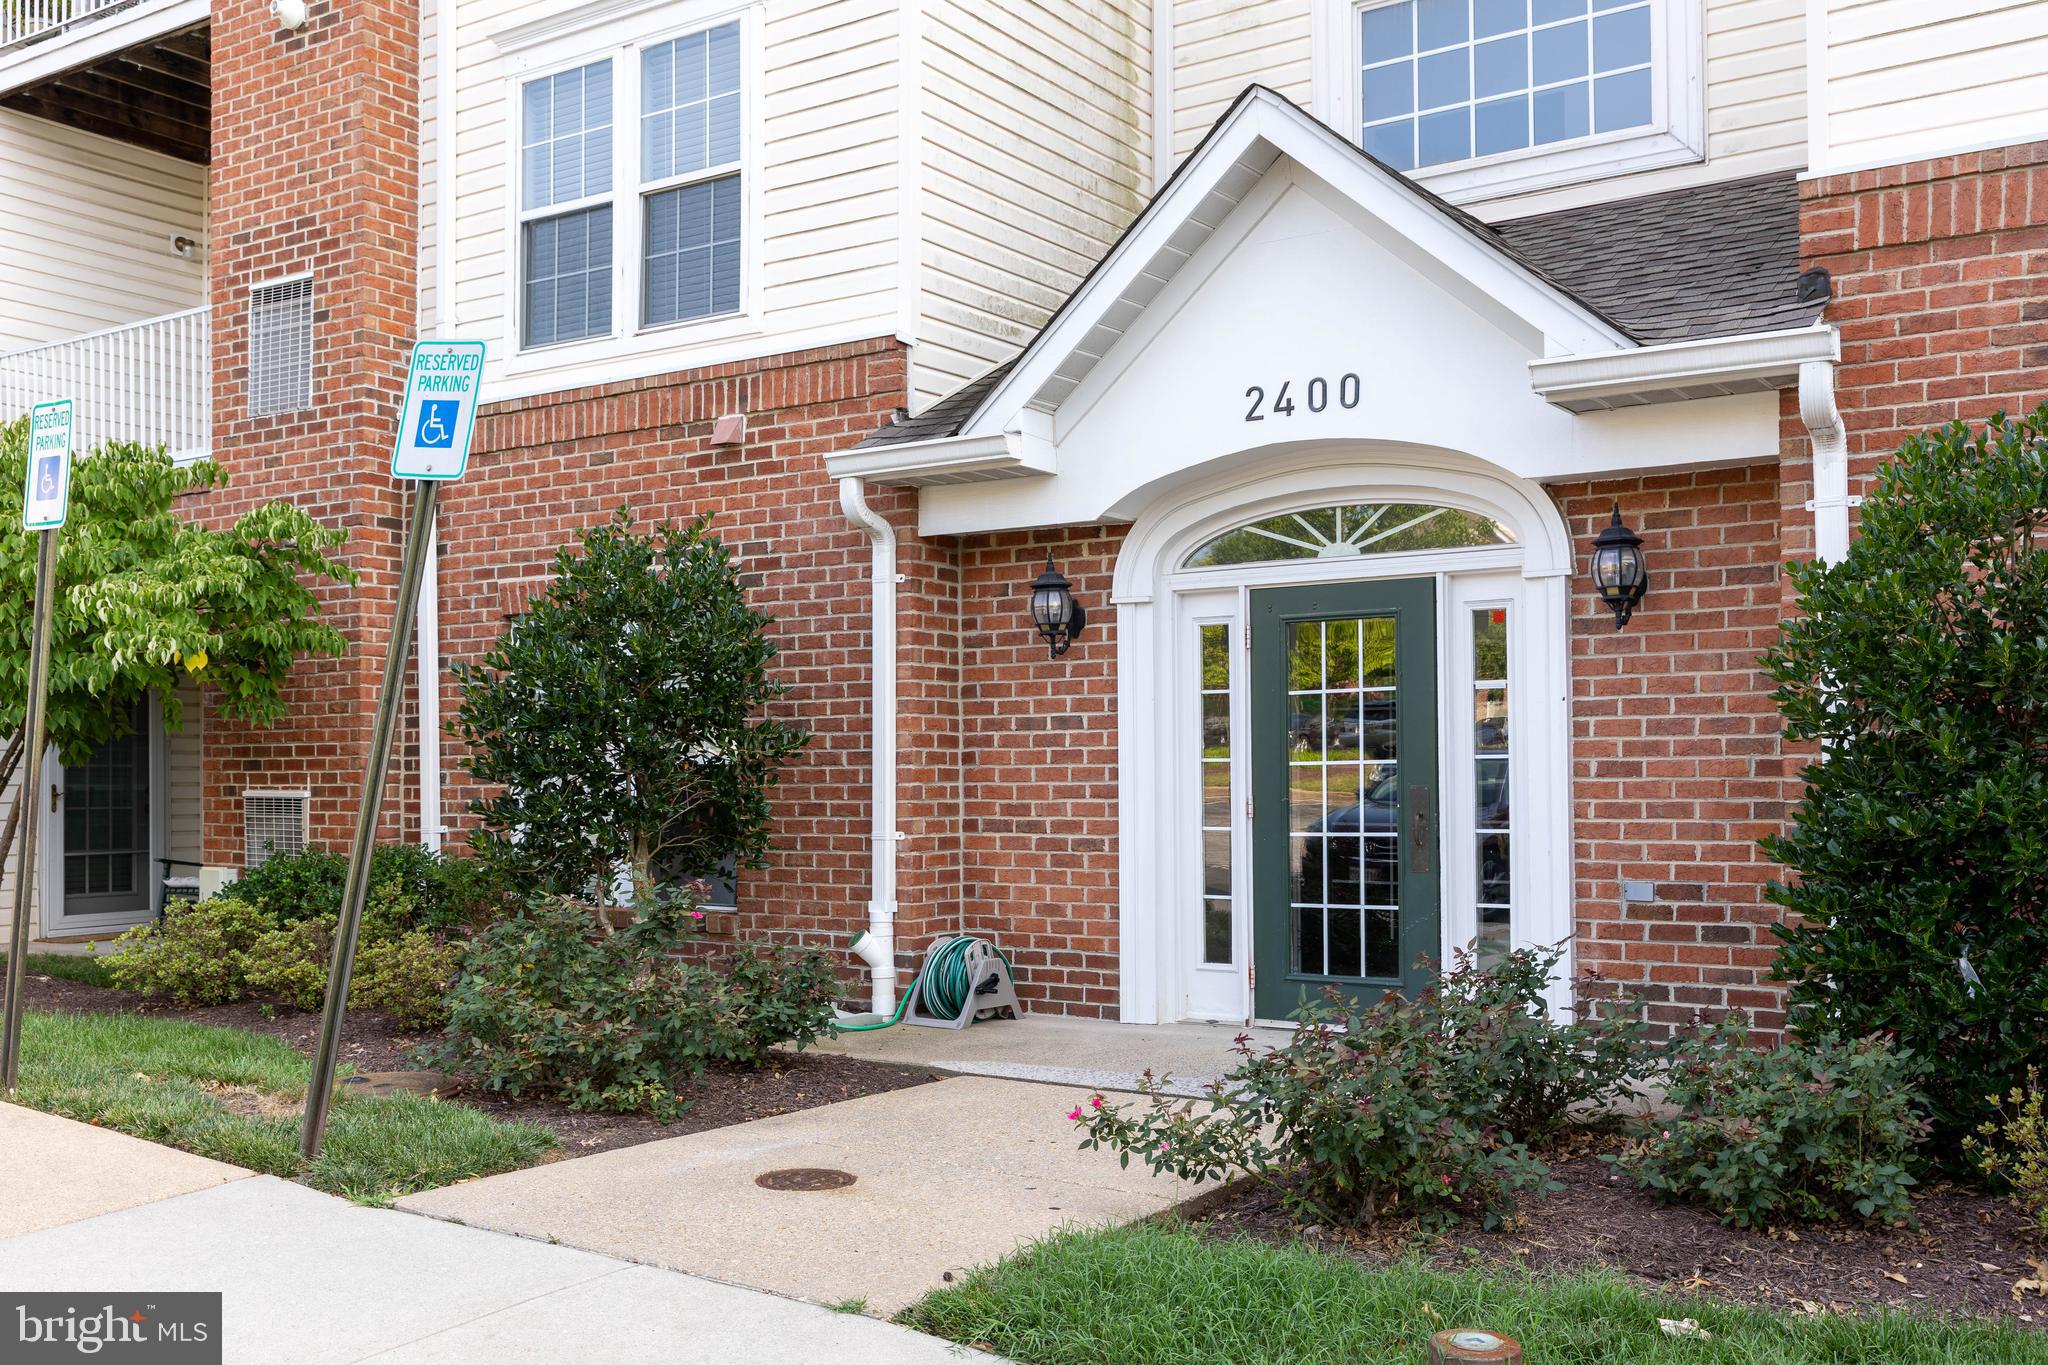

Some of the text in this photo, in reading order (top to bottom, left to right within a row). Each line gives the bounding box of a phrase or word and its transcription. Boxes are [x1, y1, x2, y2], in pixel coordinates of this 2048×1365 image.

[416, 354, 479, 371] RESERVED
[417, 375, 470, 392] PARKING
[1245, 372, 1360, 421] 2400
[34, 410, 69, 430] RESERVED
[35, 432, 66, 451] PARKING
